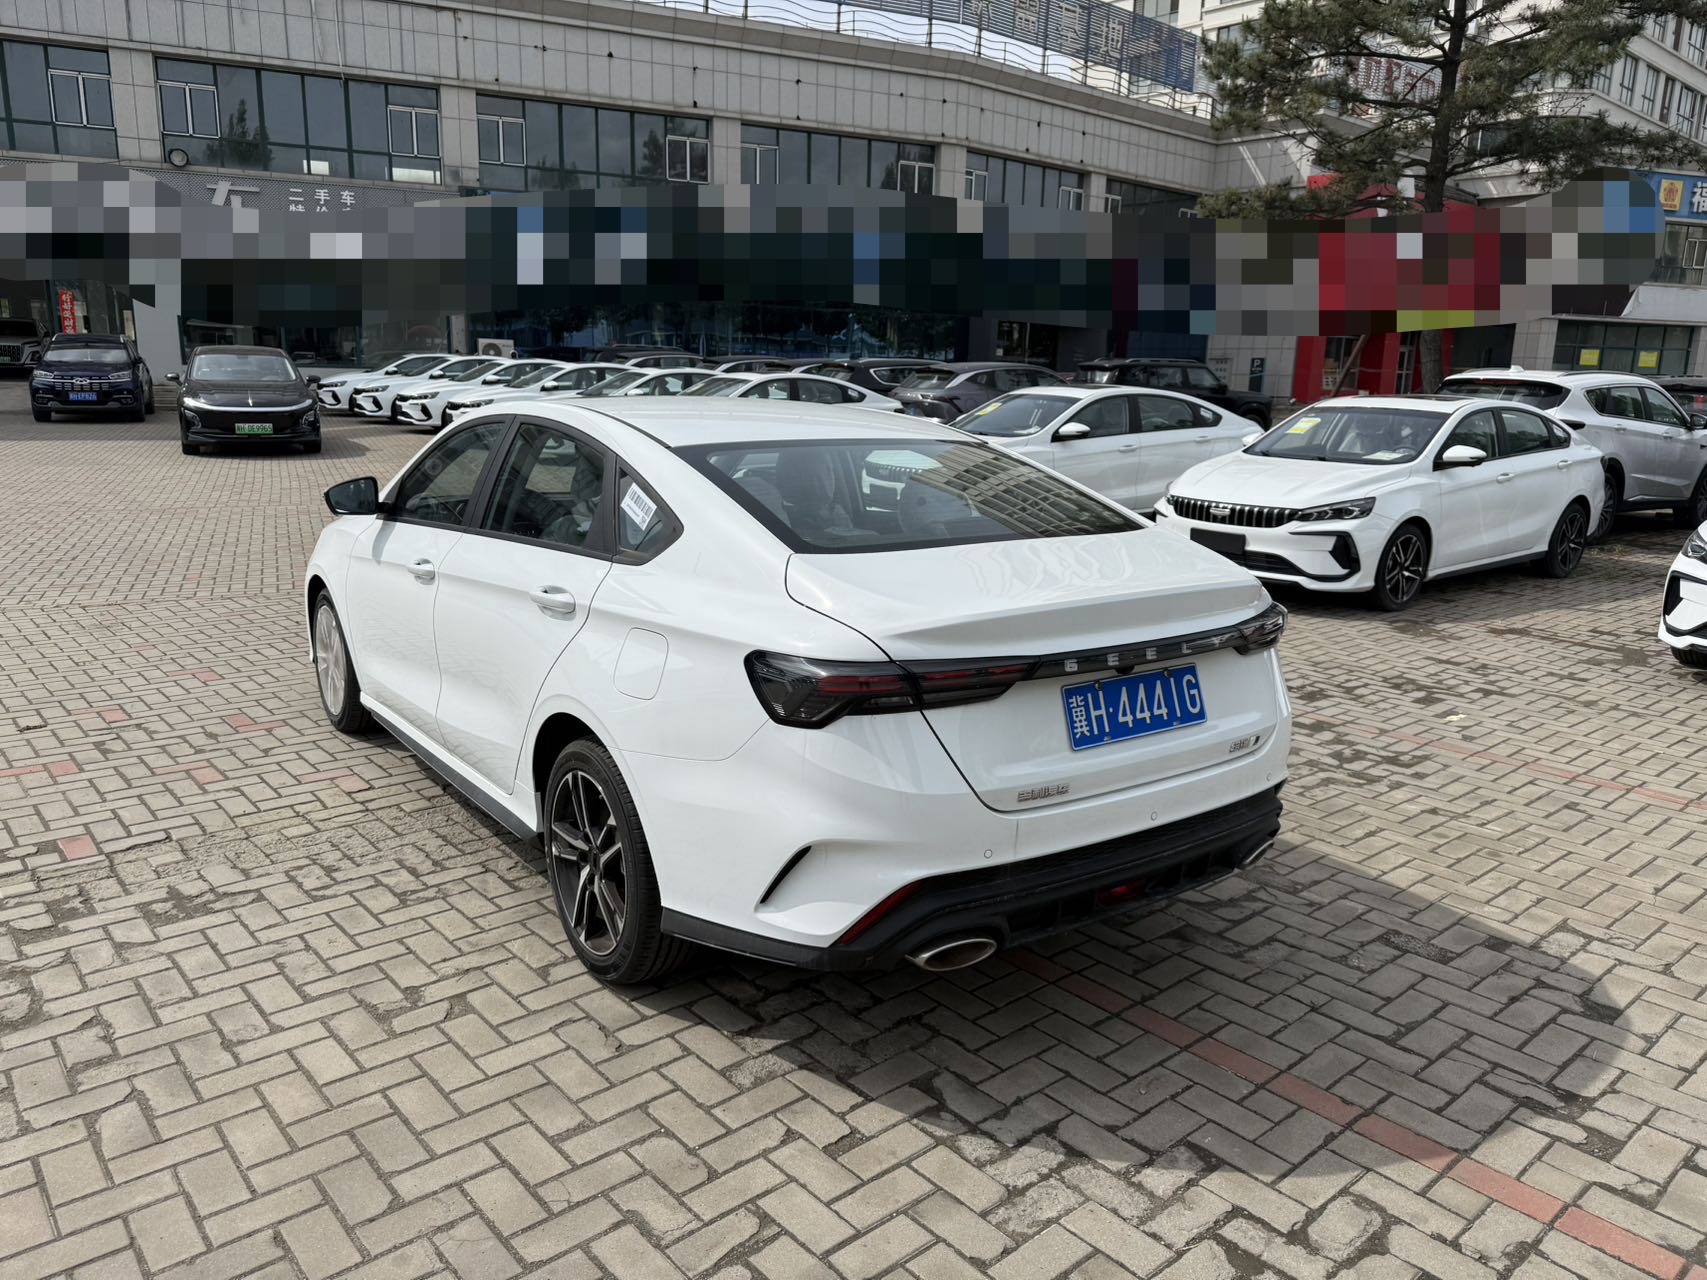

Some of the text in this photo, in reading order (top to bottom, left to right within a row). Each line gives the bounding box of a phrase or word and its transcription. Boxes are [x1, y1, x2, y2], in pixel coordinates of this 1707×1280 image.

[288, 188, 355, 206] 二手车
[1254, 359, 1262, 368] P
